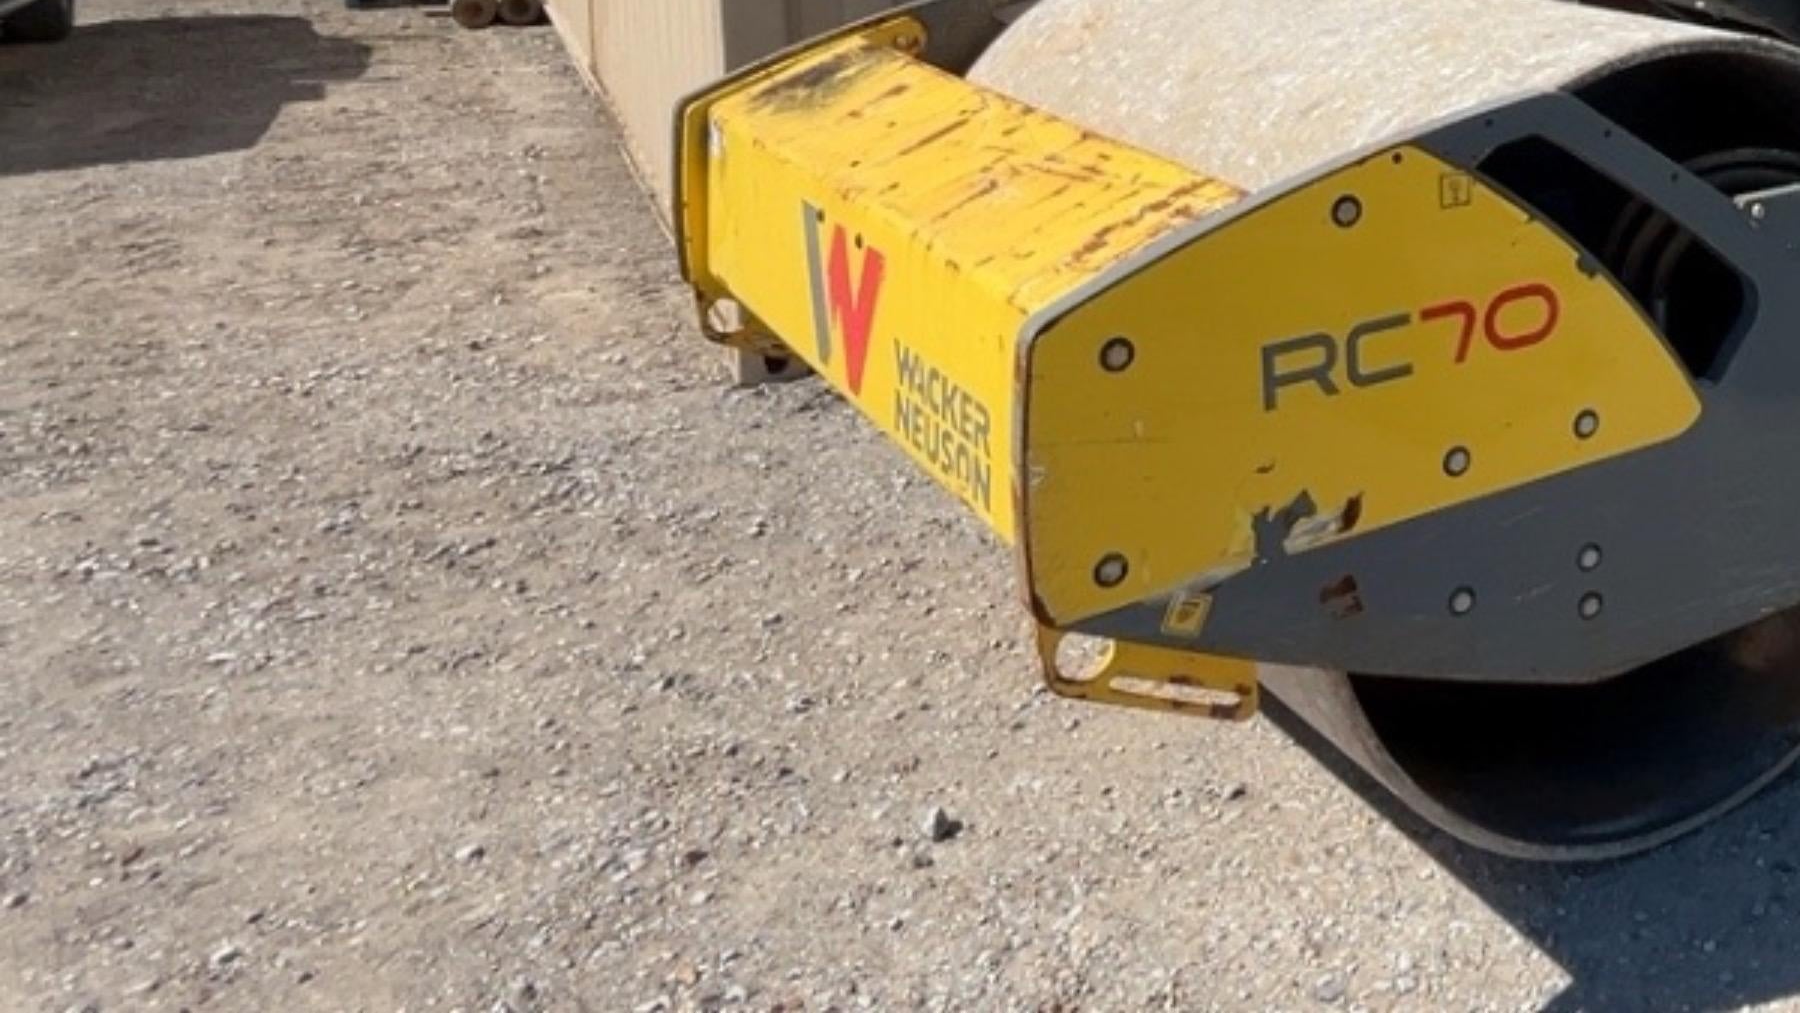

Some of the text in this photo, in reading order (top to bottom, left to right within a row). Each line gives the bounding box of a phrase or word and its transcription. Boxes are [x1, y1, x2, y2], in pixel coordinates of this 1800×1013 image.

[893, 338, 990, 458] WACKER
[1261, 283, 1559, 412] RC70
[893, 390, 990, 513] NEUSON
